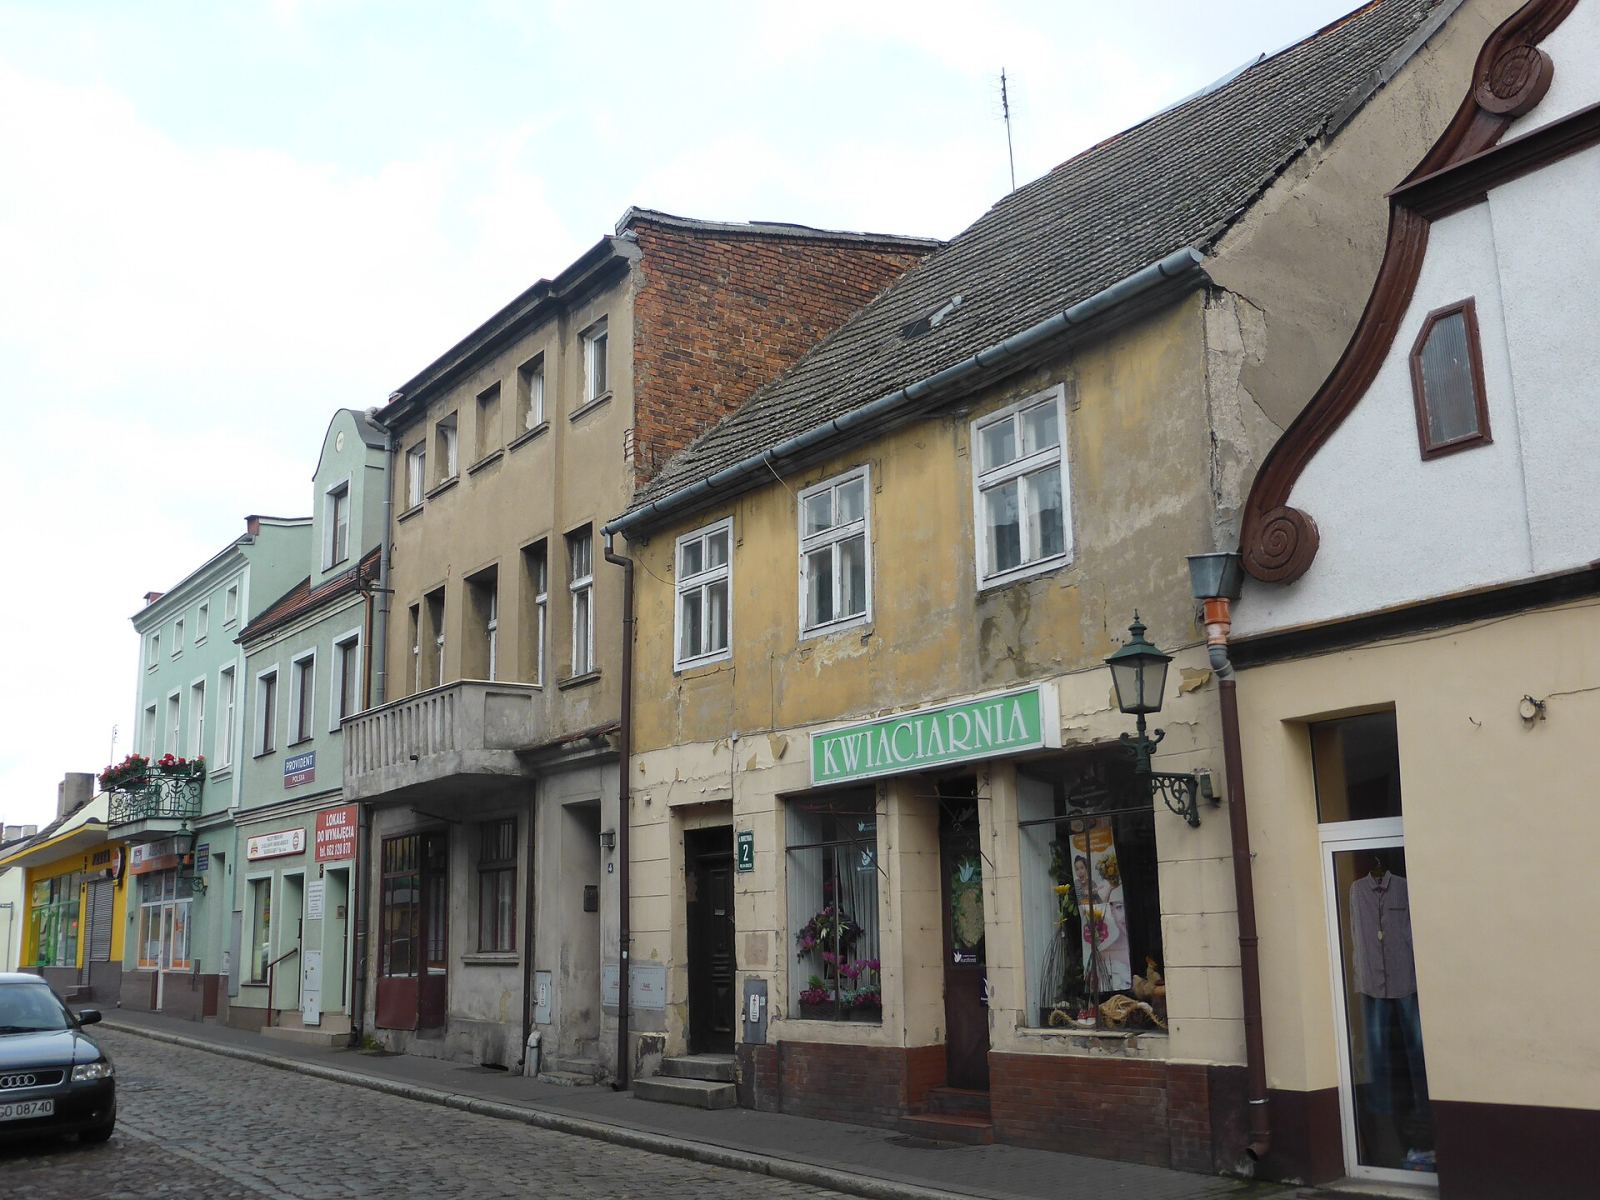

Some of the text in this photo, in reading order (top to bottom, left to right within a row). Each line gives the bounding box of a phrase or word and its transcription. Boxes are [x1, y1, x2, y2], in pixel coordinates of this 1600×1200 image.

[822, 699, 1029, 776] KWIACIARNIA
[285, 755, 314, 773] PROVIDENT
[325, 811, 346, 827] LOKALE
[317, 825, 354, 843] DO WYNAJĘCIA
[743, 844, 749, 862] 2
[16, 1101, 52, 1116] 08740
